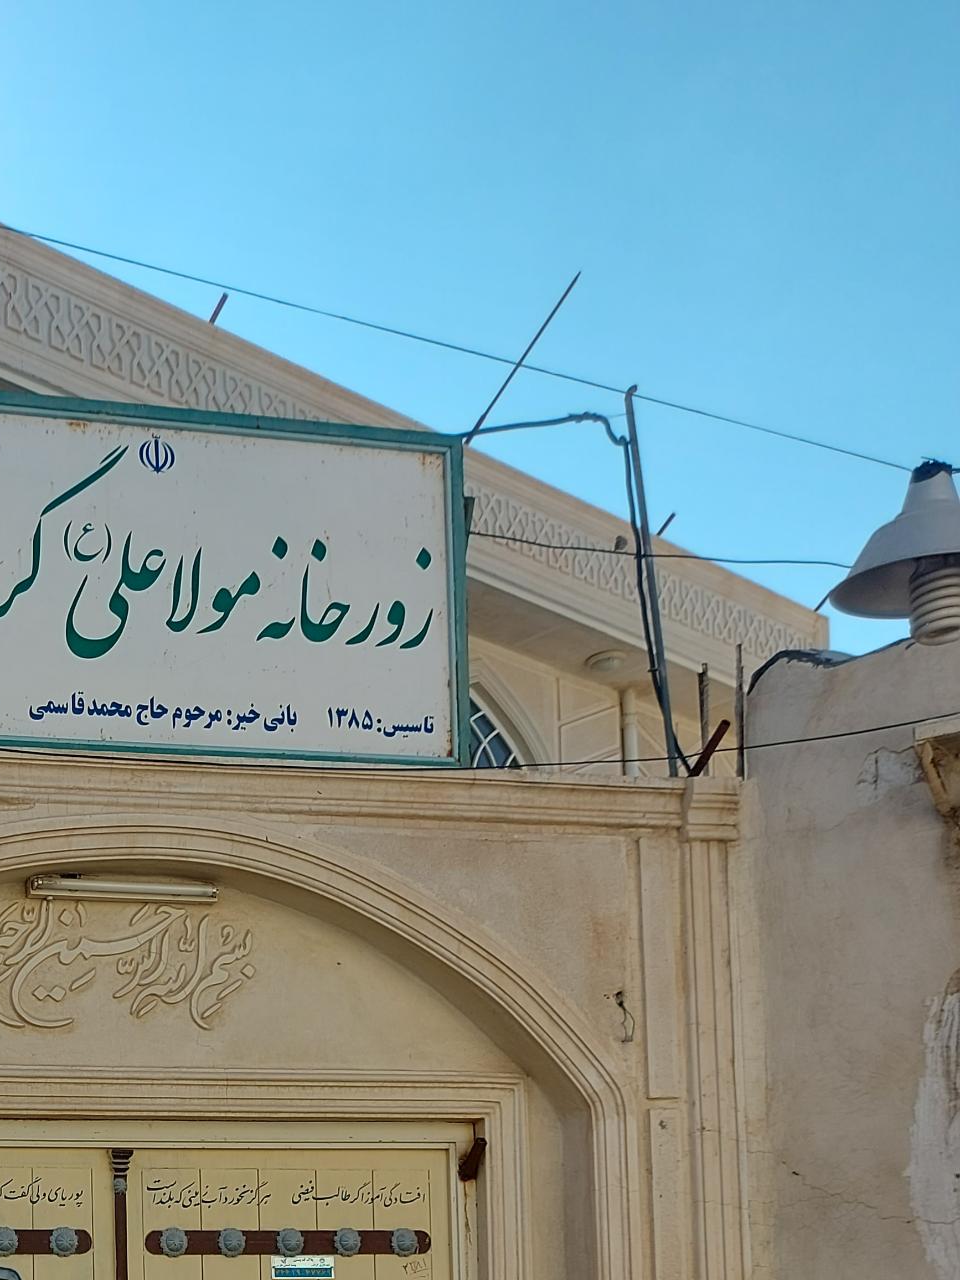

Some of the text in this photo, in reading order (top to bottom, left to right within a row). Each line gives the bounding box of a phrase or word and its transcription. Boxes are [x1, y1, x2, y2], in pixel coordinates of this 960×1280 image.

[63, 519, 113, 565] (ع)
[65, 530, 167, 659] علی
[166, 546, 260, 633] مولا
[256, 536, 434, 650] زورخانه
[28, 690, 298, 733] بانی خیر: مرحوم حاج محمد قاسمی
[327, 706, 374, 731] ۱۳۸۵
[190, 925, 257, 1031] بسم
[4, 1176, 42, 1200] گفت
[30, 1183, 47, 1205] ولی
[47, 1185, 84, 1208] پوریای
[175, 1181, 196, 1204] که
[201, 1185, 229, 1209] آب
[221, 1184, 251, 1206] نخورد
[246, 1180, 272, 1206] هرگز
[291, 1180, 315, 1205] فیضی
[311, 1185, 351, 1207] طالب
[349, 1181, 372, 1204] اگر
[363, 1186, 387, 1205] آموز
